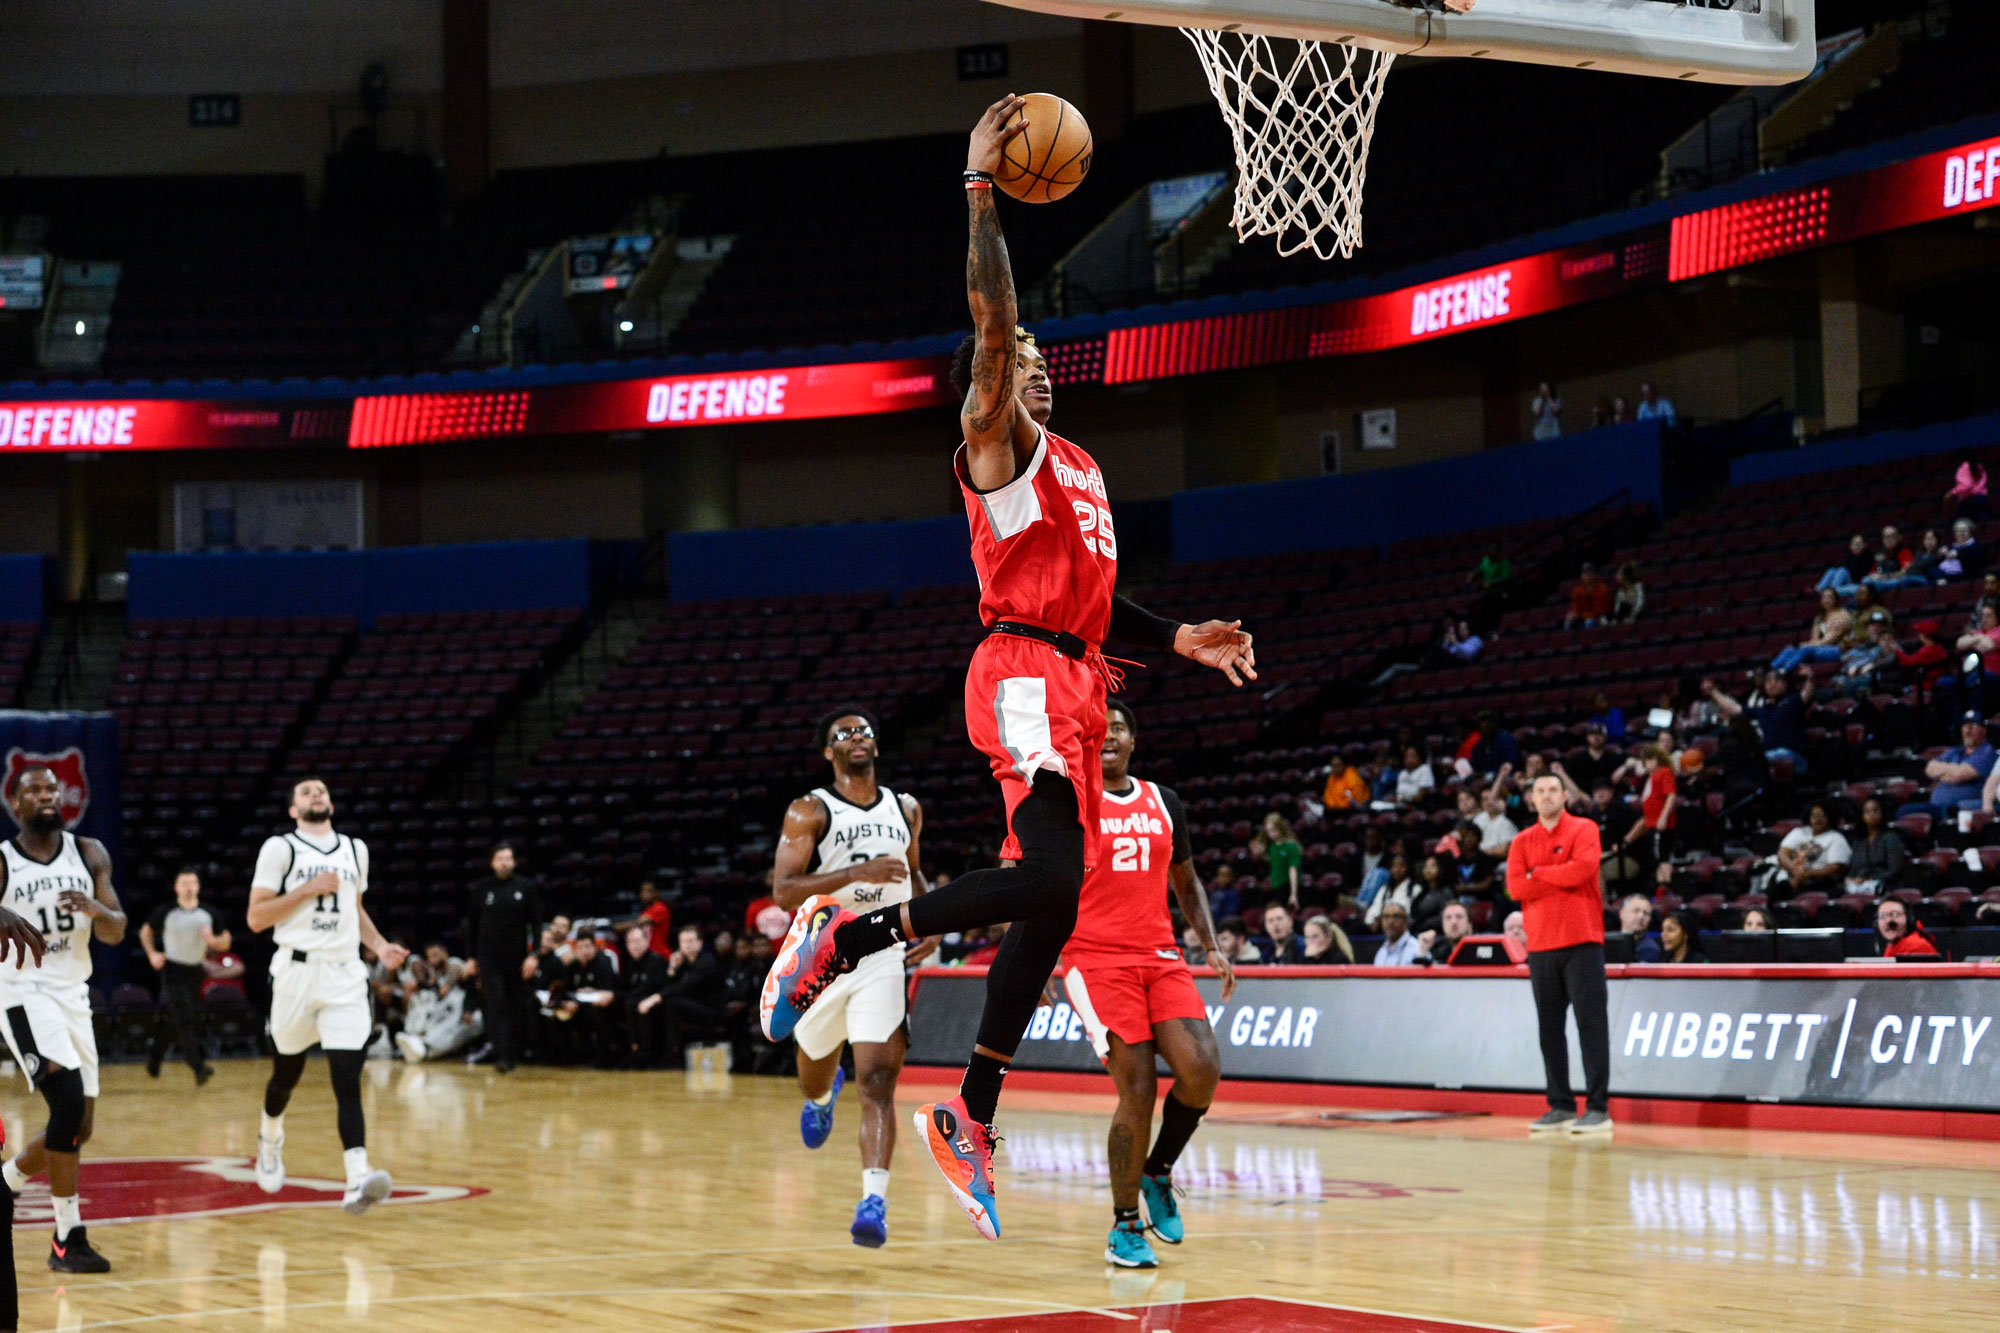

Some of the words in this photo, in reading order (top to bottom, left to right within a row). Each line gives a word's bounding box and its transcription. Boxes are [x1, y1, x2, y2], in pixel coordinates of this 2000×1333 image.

[1411, 269, 1511, 334] DEFENSE
[646, 375, 788, 422] DEFENSE
[0, 407, 137, 446] DEFENSE
[1072, 500, 1117, 560] 25
[834, 824, 906, 847] AUSTIN
[1112, 837, 1150, 871] 21
[14, 875, 88, 903] AUSTIN
[315, 891, 340, 912] 11
[38, 904, 75, 934] 15
[1230, 1006, 1319, 1047] GEAR
[1624, 1011, 1820, 1061] HIBBETT
[1870, 1015, 1992, 1065] CITY
